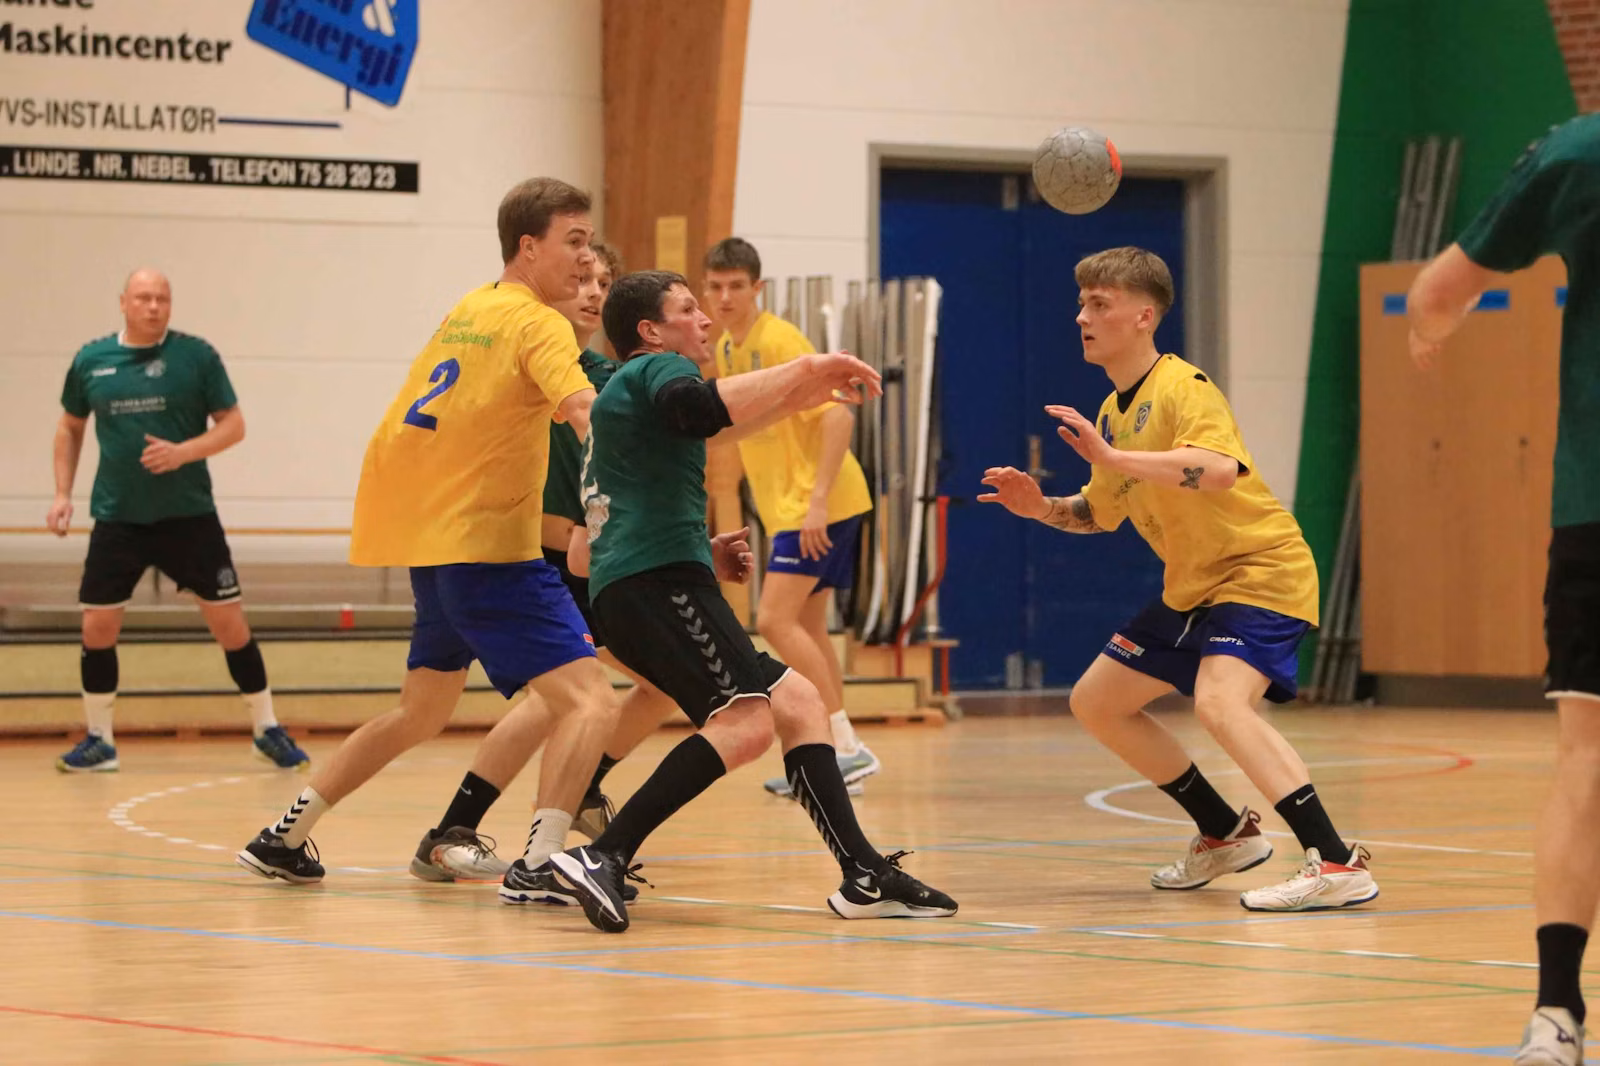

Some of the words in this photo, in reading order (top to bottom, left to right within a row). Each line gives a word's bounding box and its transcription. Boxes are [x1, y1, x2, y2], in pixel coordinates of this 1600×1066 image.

[262, 0, 404, 87] Energi
[0, 97, 216, 134] VS-INSTALLATØR
[13, 149, 80, 177] LUNDE
[94, 154, 127, 179] NR.
[131, 155, 196, 181] NEBEL
[209, 157, 296, 187] TELEFON
[299, 162, 321, 188] 75
[324, 163, 348, 189] 28
[374, 165, 397, 190] 23
[403, 357, 461, 432] 2
